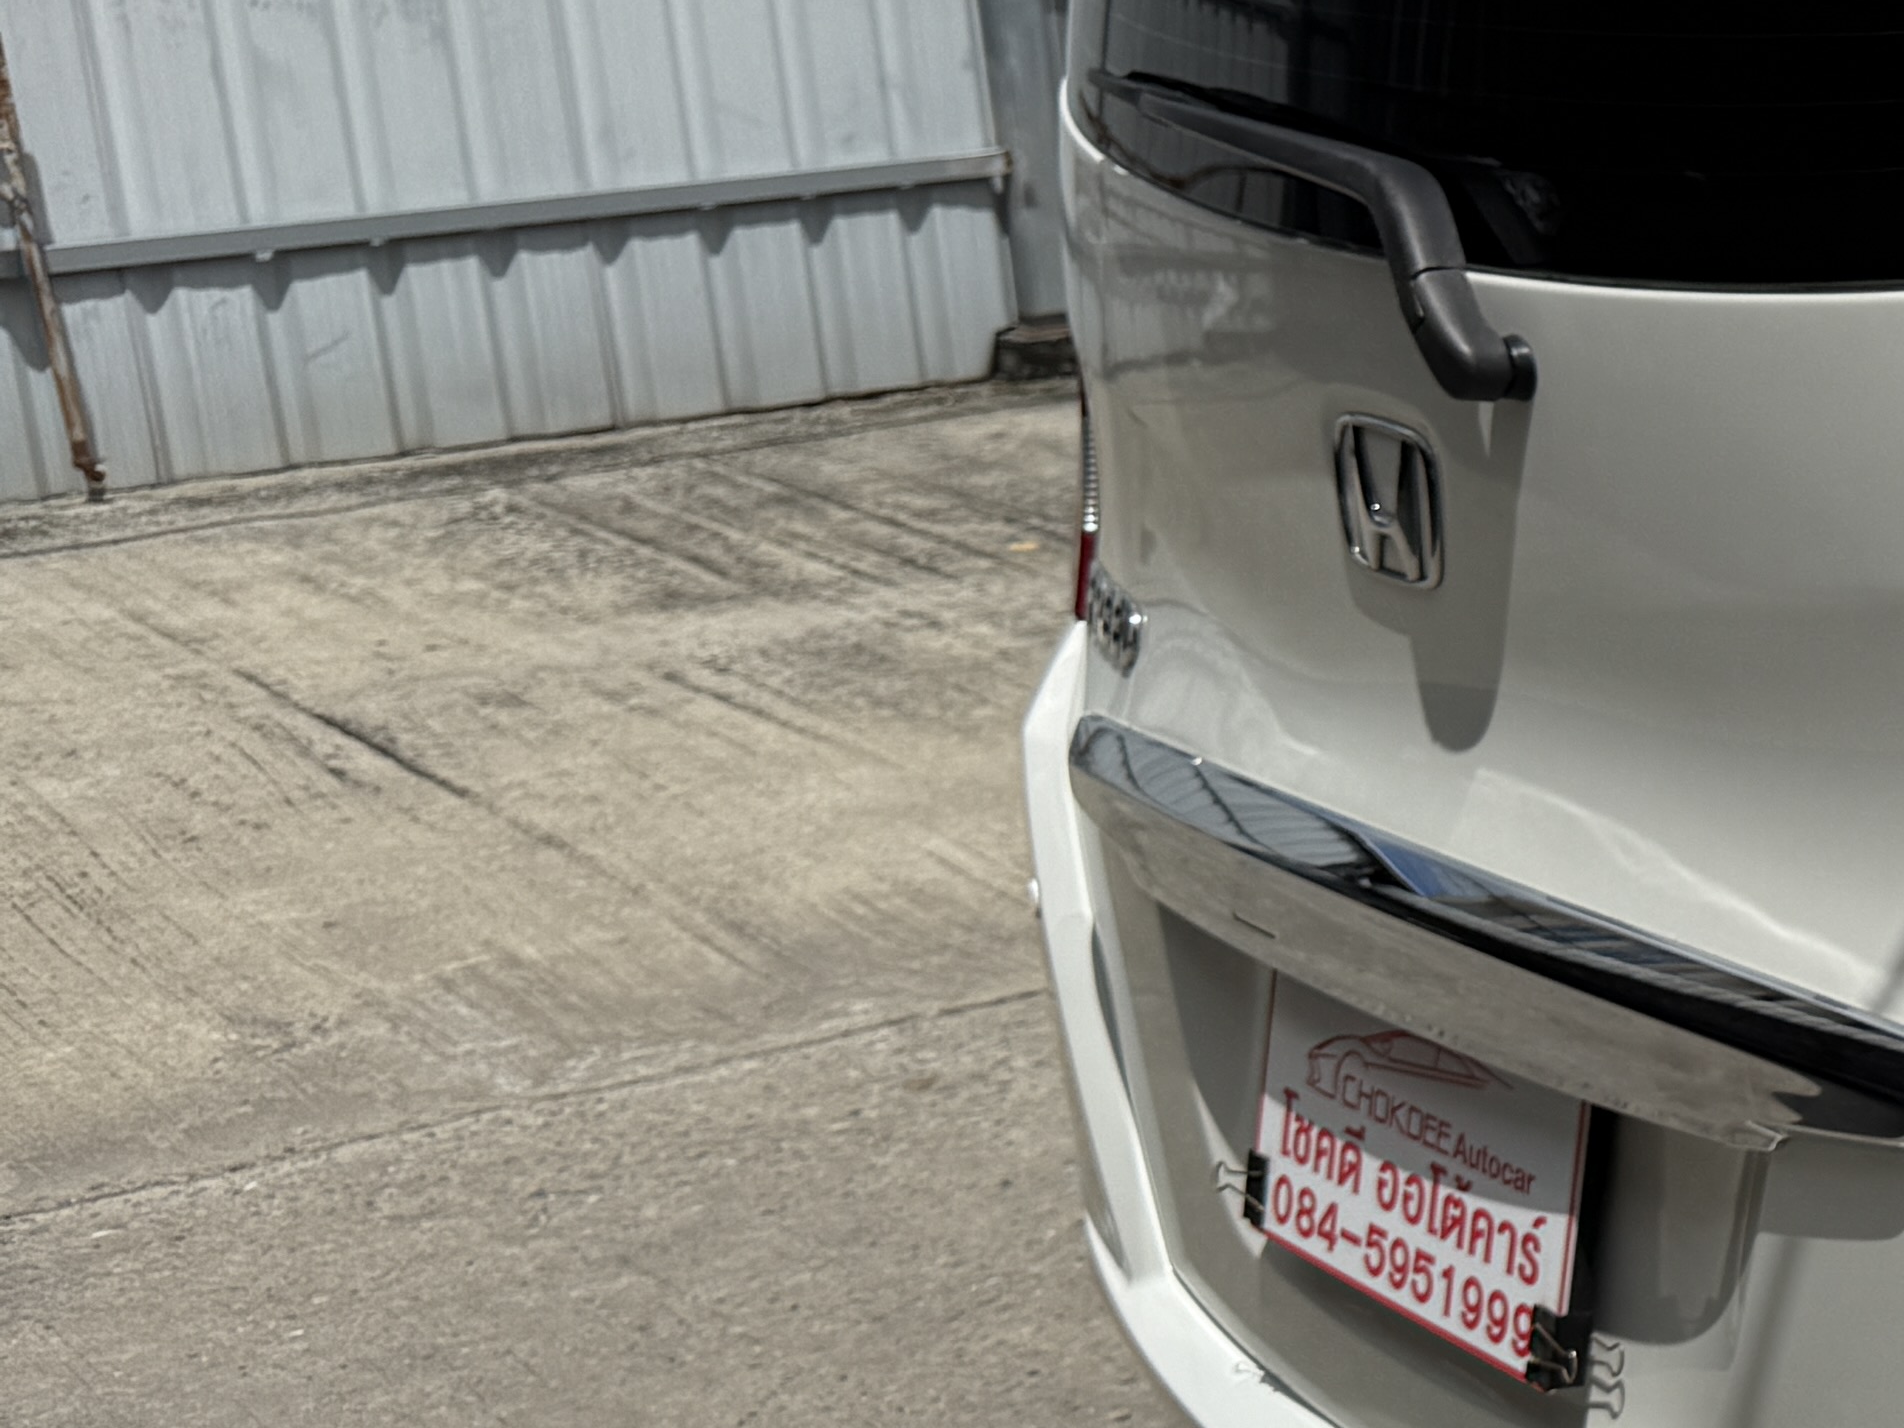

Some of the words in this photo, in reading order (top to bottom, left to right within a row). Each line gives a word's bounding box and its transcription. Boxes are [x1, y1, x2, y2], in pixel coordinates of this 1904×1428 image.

[1279, 1088, 1366, 1195] โชคดี
[1375, 1160, 1548, 1286] ออโต้คาร์
[1452, 1136, 1536, 1196] Autocar
[1270, 1172, 1536, 1358] 084-5951999
